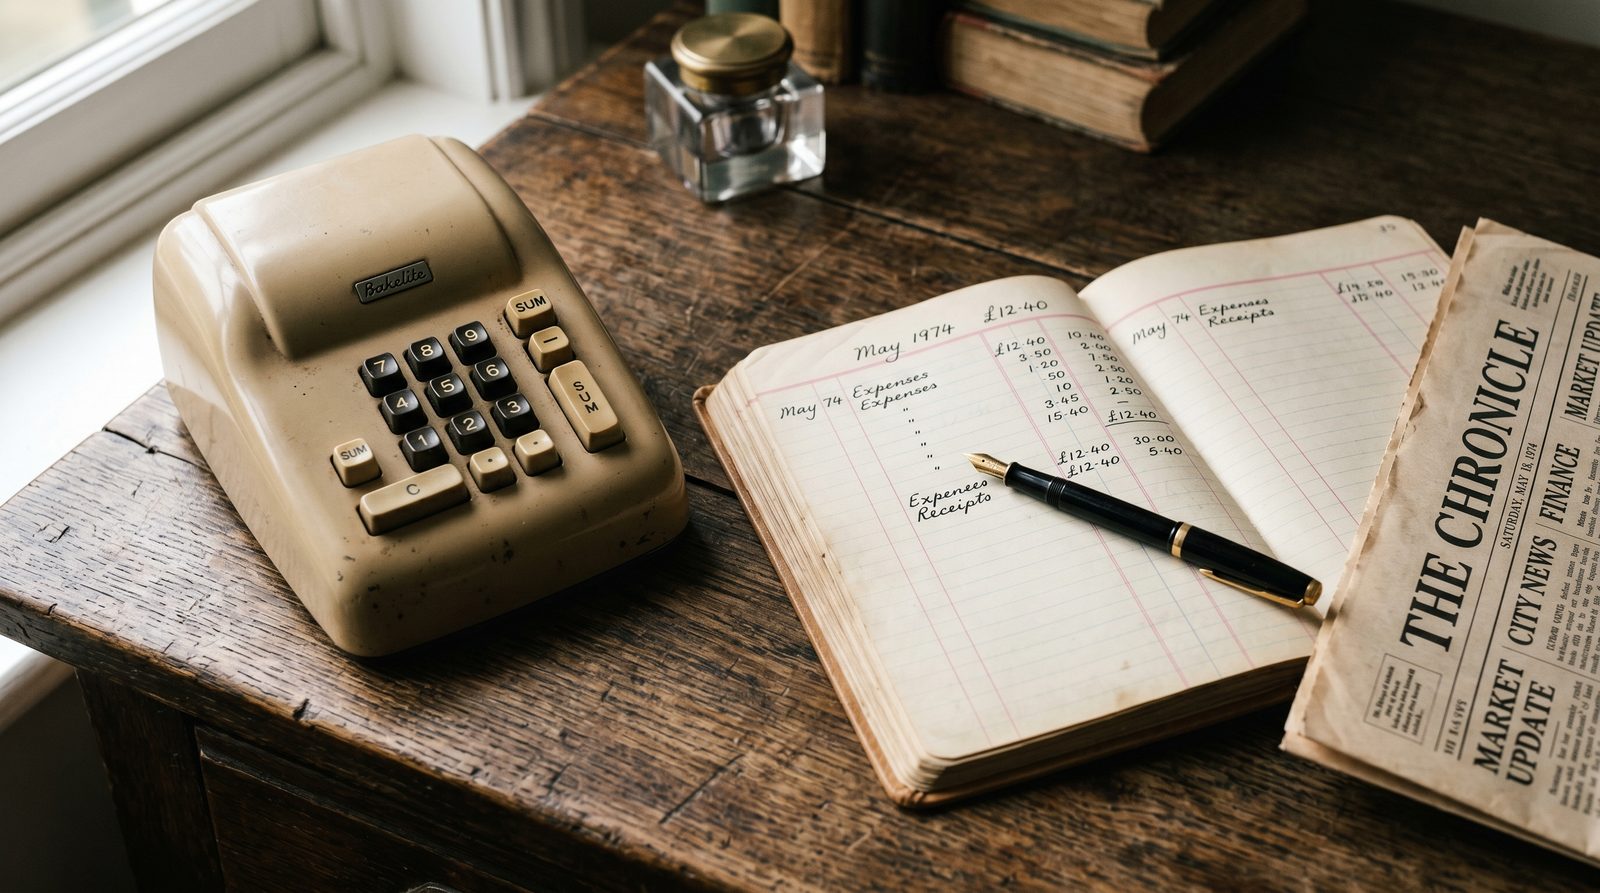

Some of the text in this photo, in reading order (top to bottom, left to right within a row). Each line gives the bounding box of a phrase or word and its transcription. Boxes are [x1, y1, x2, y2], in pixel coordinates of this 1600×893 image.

[365, 268, 426, 297] Bakelite
[515, 295, 547, 313] SUM
[1132, 322, 1166, 345] May
[1171, 312, 1191, 324] 74
[1198, 298, 1269, 316] Expenses
[1208, 308, 1275, 328] Receipts
[464, 329, 478, 342] 9
[855, 342, 901, 363] May
[912, 323, 955, 343] 1974
[420, 344, 434, 357] 8
[373, 360, 386, 373] 7
[485, 364, 499, 377] 6
[441, 379, 455, 393] 5
[572, 381, 599, 414] SUM
[780, 403, 816, 421] May
[823, 396, 843, 408] 74
[852, 371, 929, 399] Expenses
[860, 382, 938, 411] Expenses
[1056, 382, 1072, 392] 10
[1564, 353, 1600, 421] MARKET
[396, 397, 409, 410] 4
[507, 401, 521, 413] 3
[463, 417, 478, 431] 2
[1434, 319, 1540, 549] CHRONICLE
[340, 444, 368, 461] SUM
[418, 435, 428, 446] 1
[406, 483, 421, 496] C
[1500, 442, 1538, 549] SATURDAY, MAY 18, 1974
[1538, 443, 1581, 525] FINANCE
[1399, 552, 1473, 653] THE
[1507, 535, 1558, 646] CITY NEWS
[1473, 658, 1525, 776] MARKET
[1505, 680, 1556, 787] UPDATE
